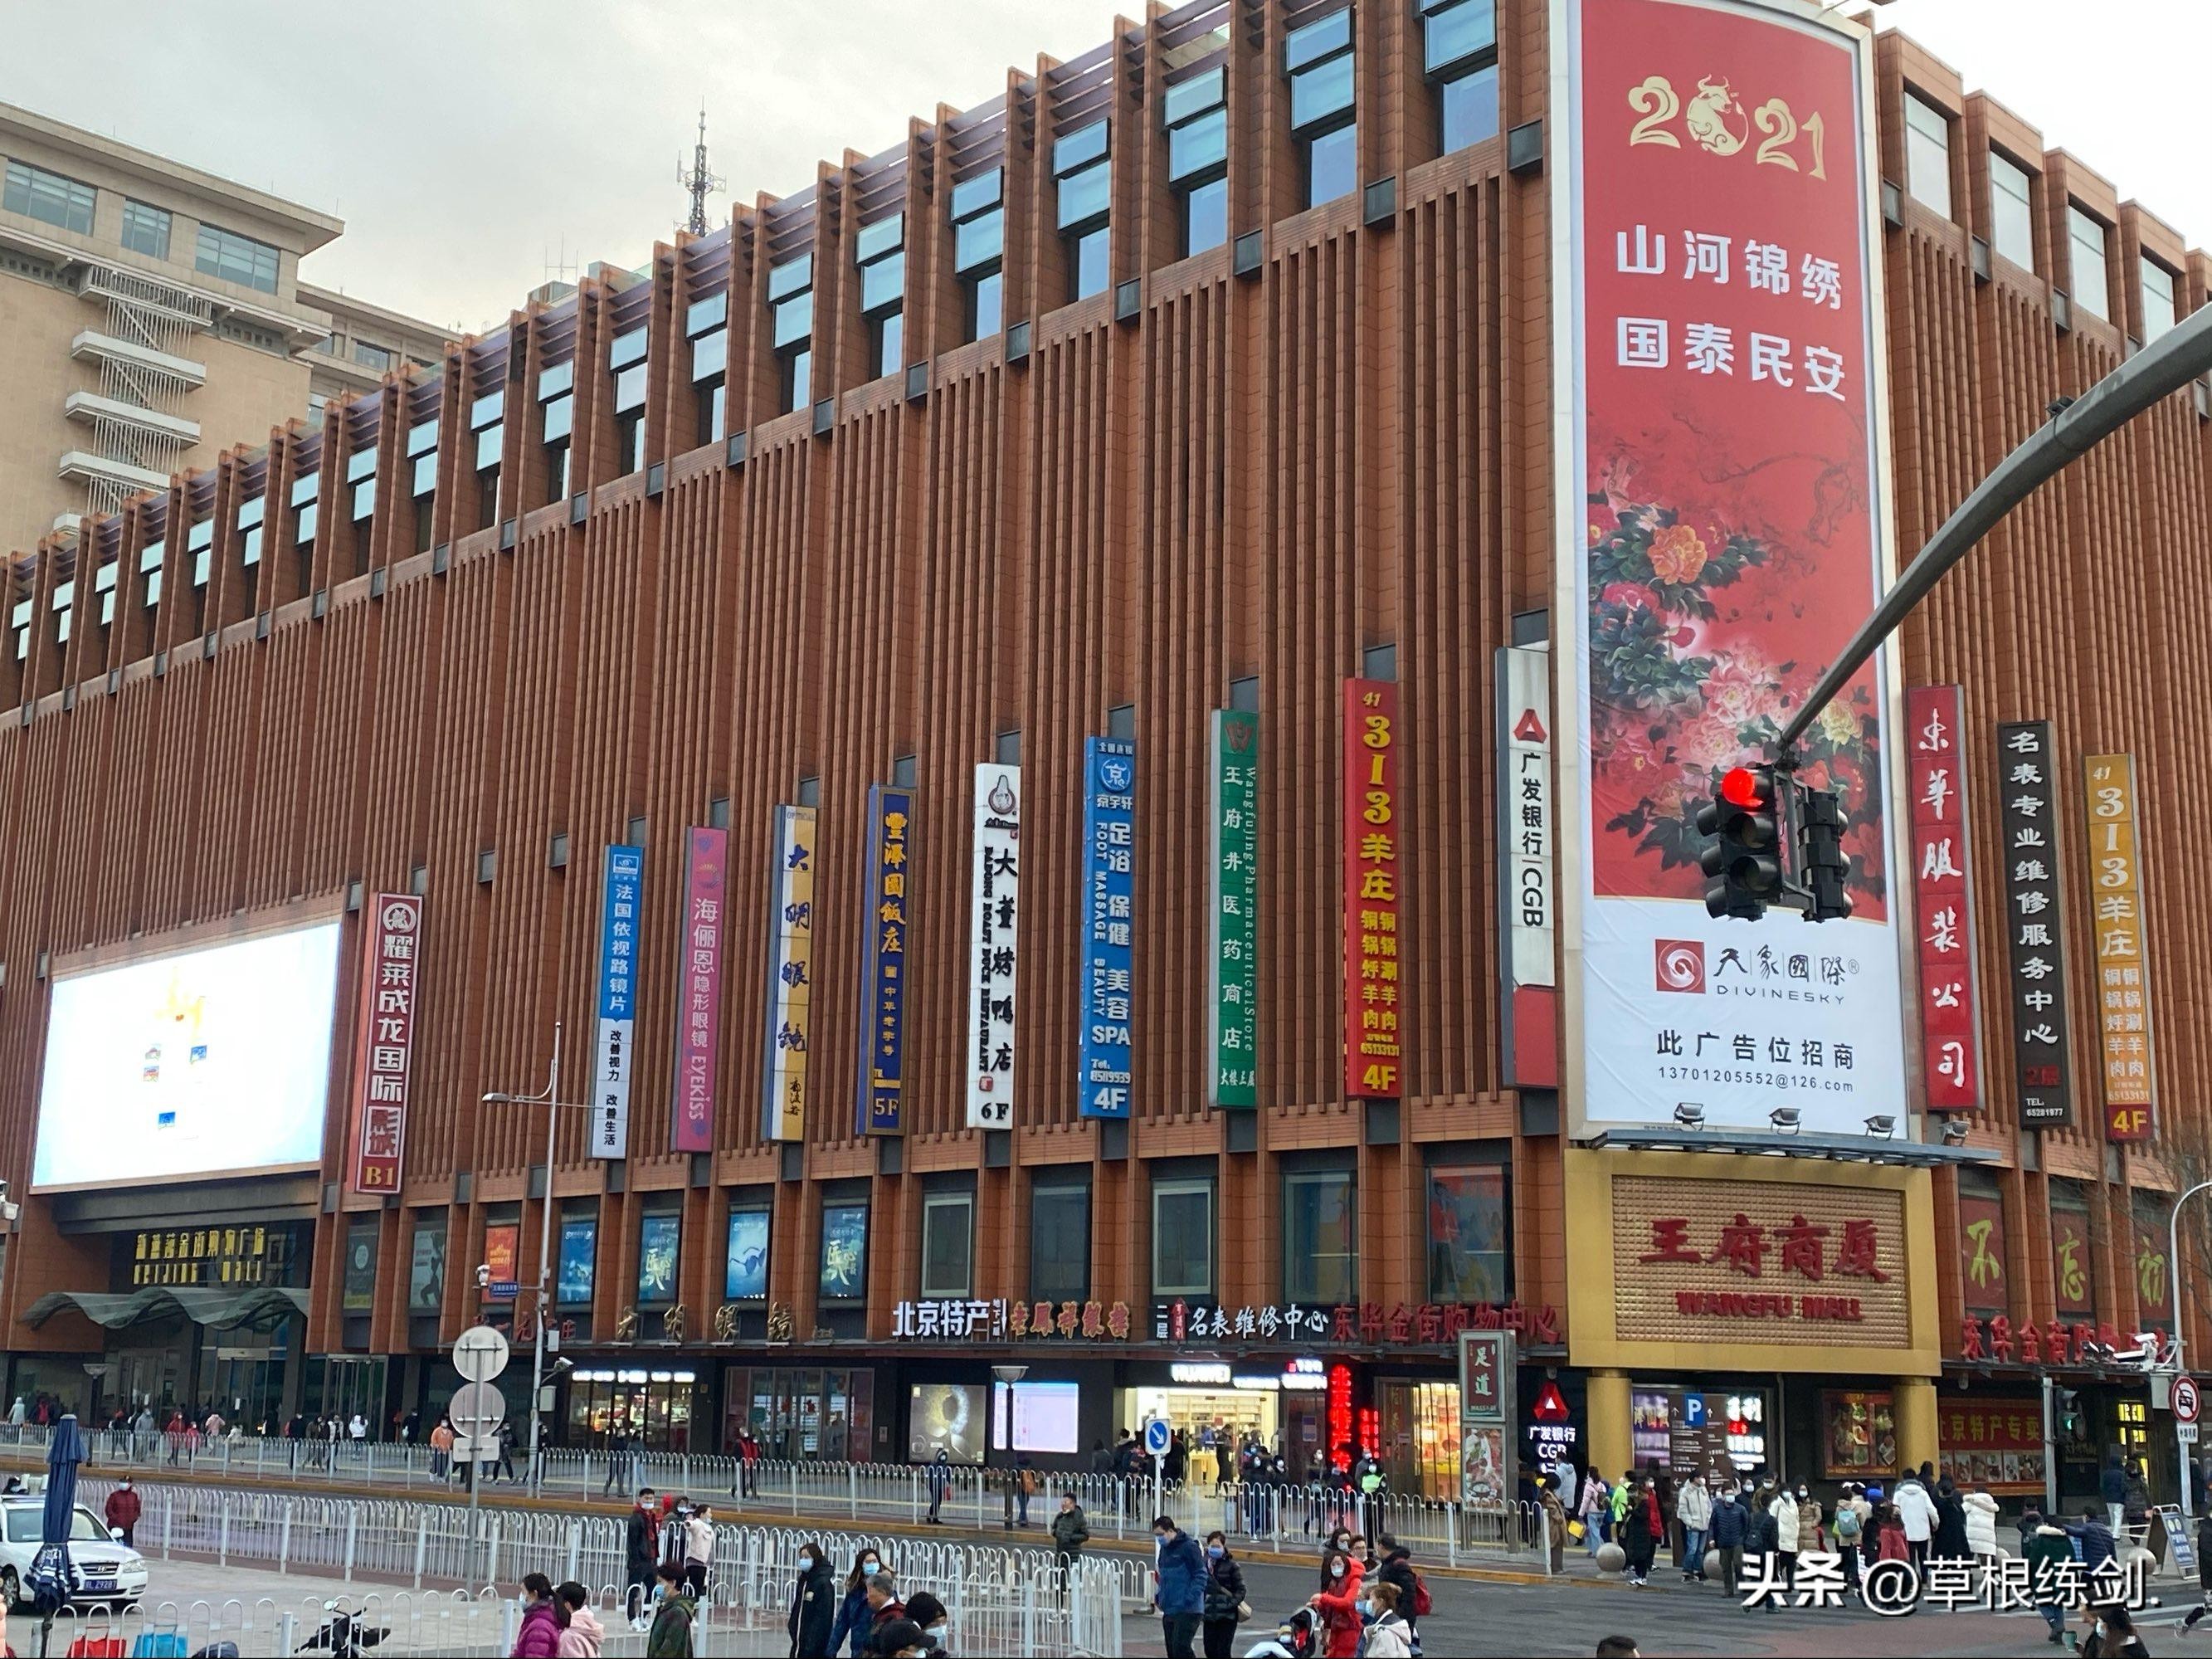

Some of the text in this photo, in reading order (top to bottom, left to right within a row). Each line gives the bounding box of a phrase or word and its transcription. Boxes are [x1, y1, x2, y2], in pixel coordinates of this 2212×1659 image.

[1617, 224, 1842, 310] 山河锦绣
[1617, 316, 1846, 402] 国泰民安
[1520, 752, 1543, 928] 广发银行 CGB
[2007, 731, 2059, 1046] 名表专业维修服务中心
[1093, 822, 1107, 1016] FOOT MASSAGE BEAUTY
[1107, 822, 1131, 1021] 足浴 保健 美容
[1222, 766, 1244, 1049] 王府井医药商店
[610, 885, 633, 1012] 法国依视路镜片
[991, 848, 1018, 1072] 大董烤鸭店
[1717, 985, 1845, 1004] DIVINESKY
[1091, 1025, 1131, 1045] SPA
[1657, 1029, 1854, 1070] 此广告位招商
[604, 1030, 621, 1146] 改善视力 改善生活
[1362, 1064, 1397, 1091] 4F
[1658, 1066, 1854, 1092] 13701205552@126.com
[875, 1097, 899, 1116] 5F
[1094, 1087, 1127, 1110] 4F
[2113, 1110, 2147, 1134] 4F
[365, 1166, 394, 1187] B1
[1640, 1213, 1891, 1283] 王府商厦
[893, 1300, 990, 1337] 北京特产
[1189, 1304, 1329, 1340] 名表维修中心
[1675, 1291, 1865, 1321] WANGFU MALL
[1688, 1398, 1703, 1422] P
[1529, 1426, 1576, 1442] 广发银行
